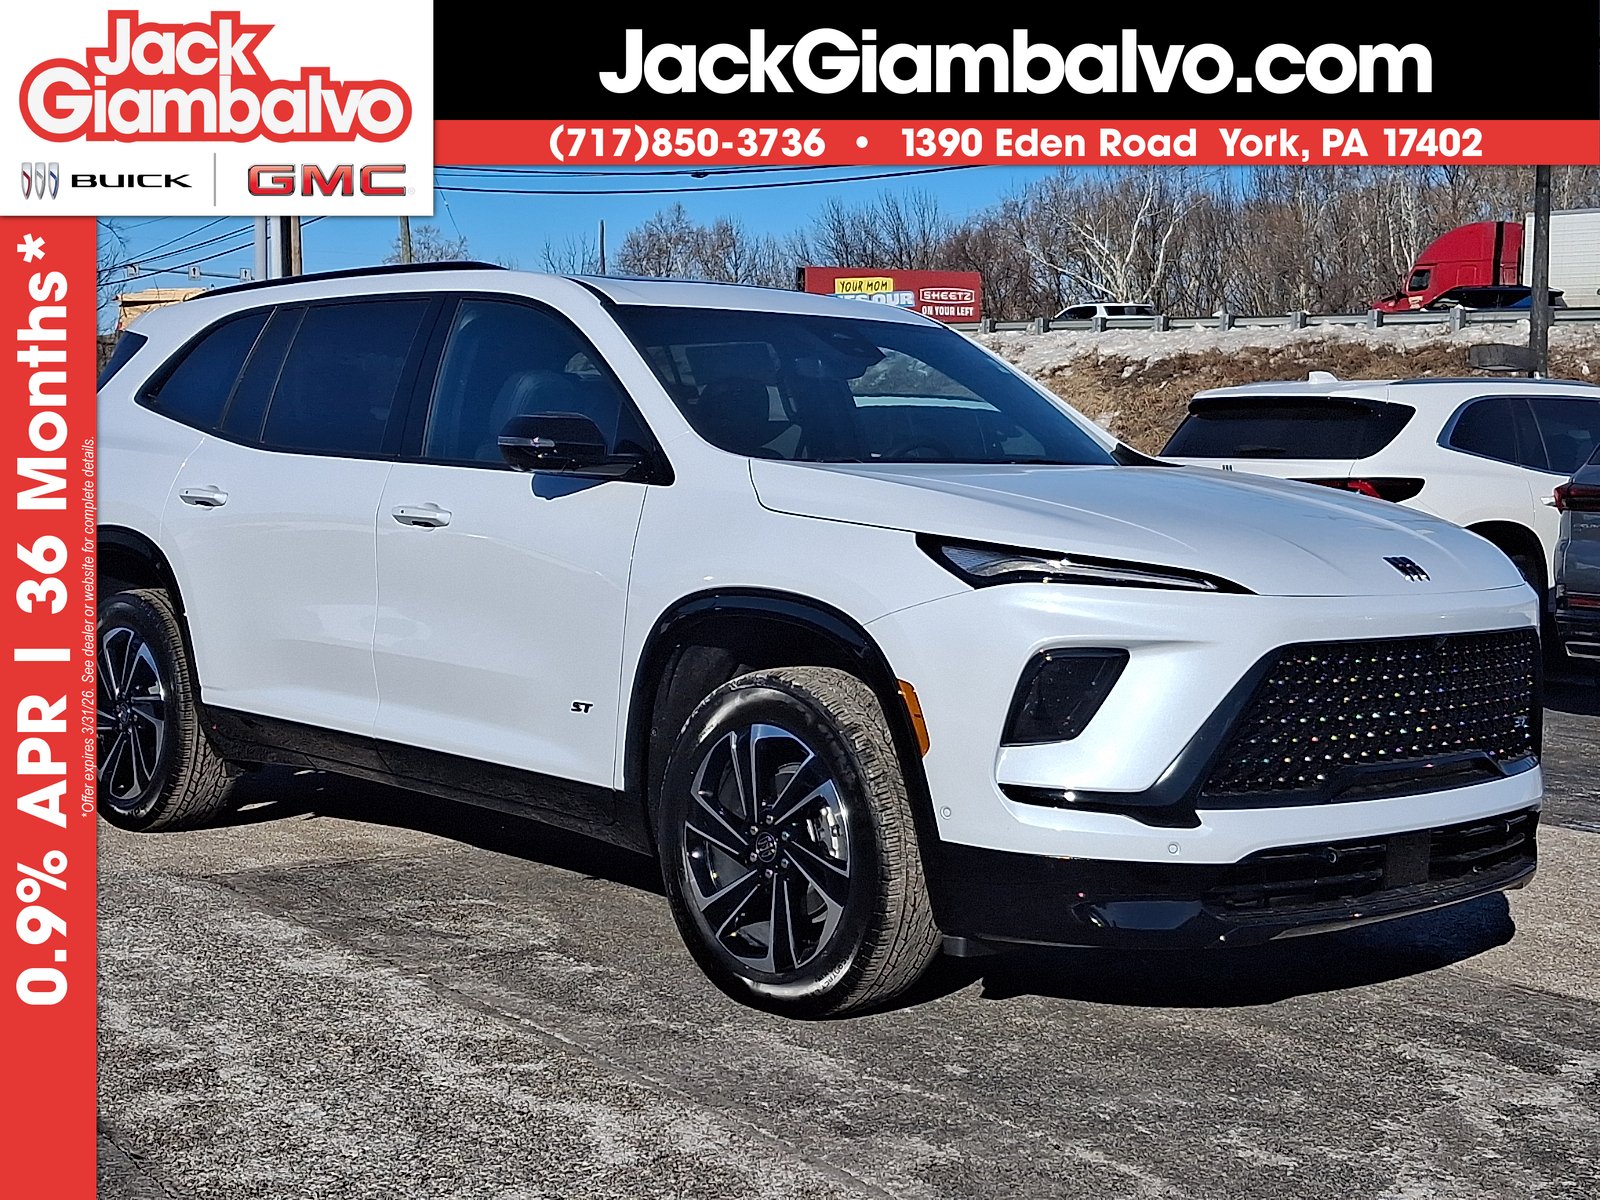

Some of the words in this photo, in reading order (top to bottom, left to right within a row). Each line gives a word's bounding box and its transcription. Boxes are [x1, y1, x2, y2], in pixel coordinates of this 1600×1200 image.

[840, 280, 863, 292] YOUR
[866, 280, 888, 291] MOM
[923, 291, 972, 300] SHEETZ
[921, 305, 933, 315] ON
[934, 306, 955, 316] YOUR
[956, 307, 974, 316] LEFT
[570, 701, 594, 714] ST
